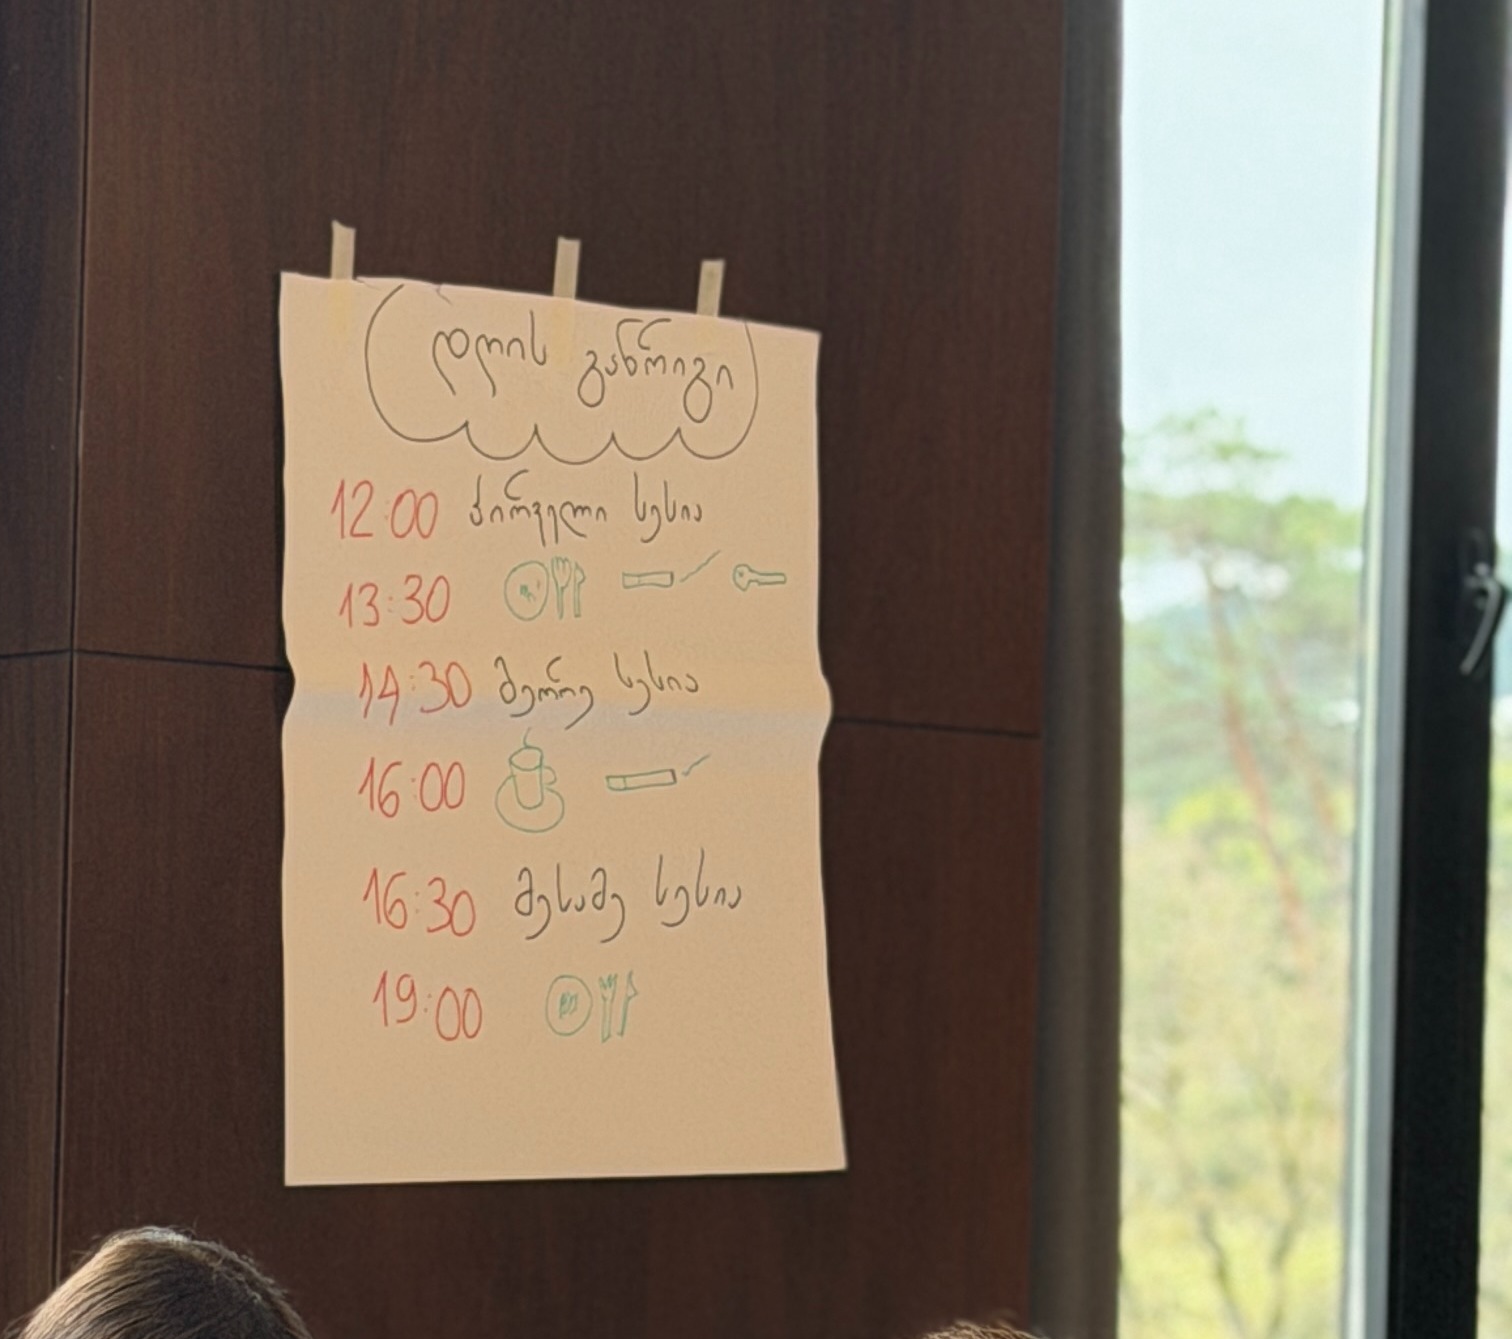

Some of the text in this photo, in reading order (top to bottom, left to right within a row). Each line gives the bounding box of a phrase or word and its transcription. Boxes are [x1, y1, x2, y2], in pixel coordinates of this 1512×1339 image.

[432, 310, 734, 423] დღის განრიგი
[470, 469, 607, 547] პირველი
[634, 472, 703, 543] სესია
[340, 574, 451, 628] 13:30
[360, 650, 699, 730] 14:30 მეორე სესია
[358, 757, 466, 818] 16:00
[363, 848, 742, 943] 16:30 მესამე სესია
[373, 971, 483, 1042] 19:00
